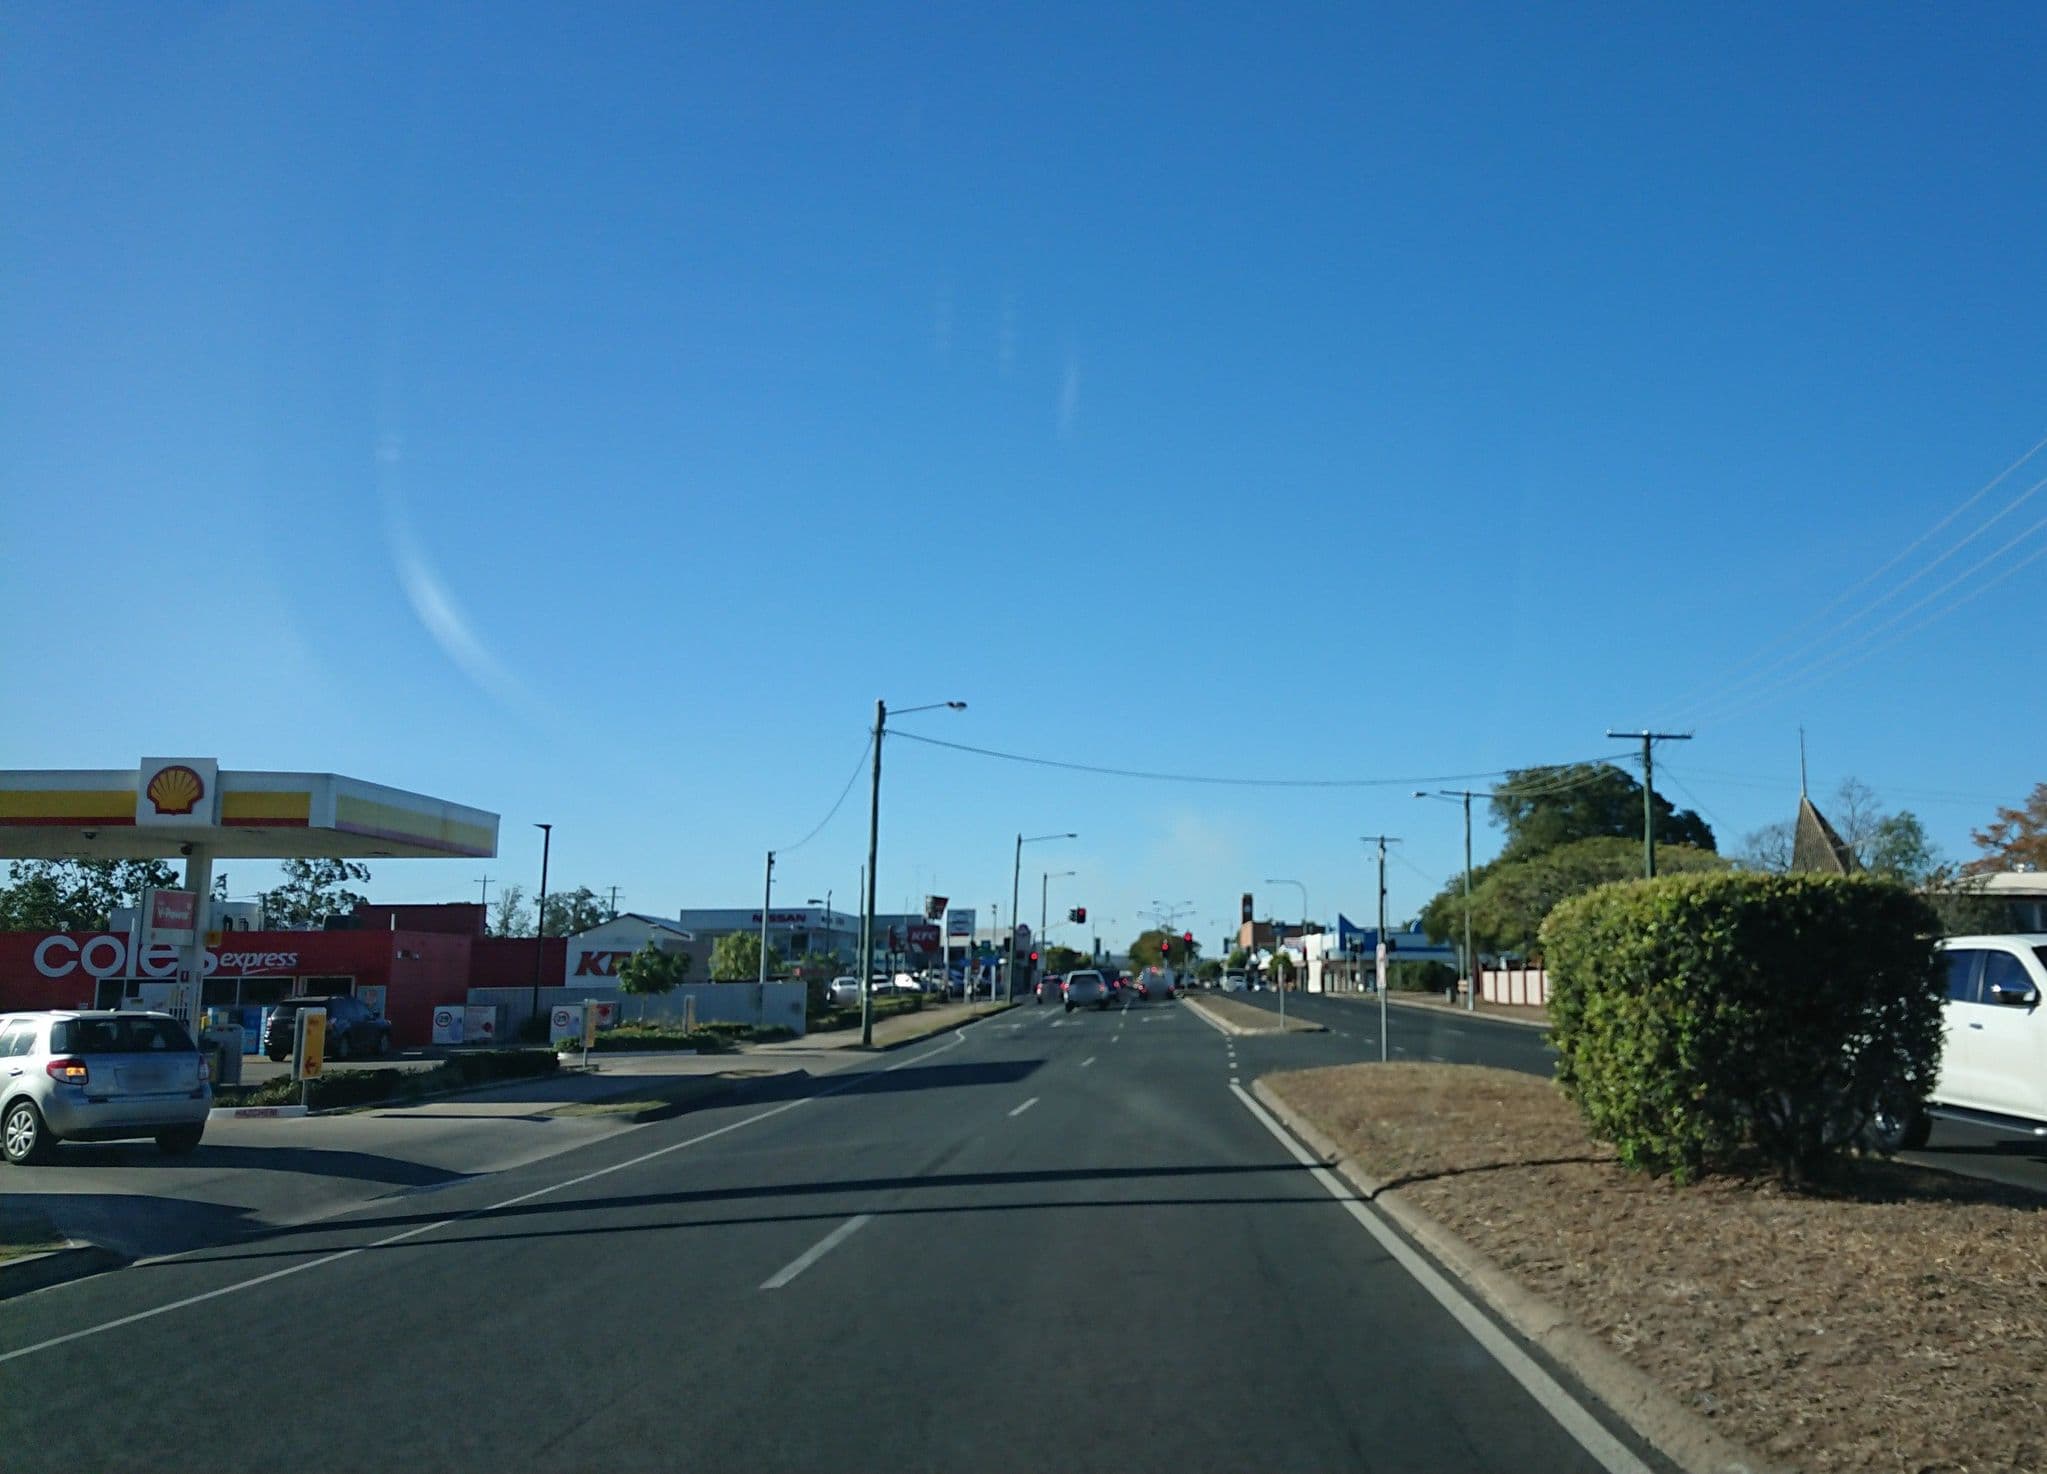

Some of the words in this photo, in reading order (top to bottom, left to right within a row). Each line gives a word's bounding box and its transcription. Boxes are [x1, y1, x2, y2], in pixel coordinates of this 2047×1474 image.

[752, 913, 807, 923] NSSAN
[911, 930, 937, 942] KFC
[220, 951, 298, 975] express
